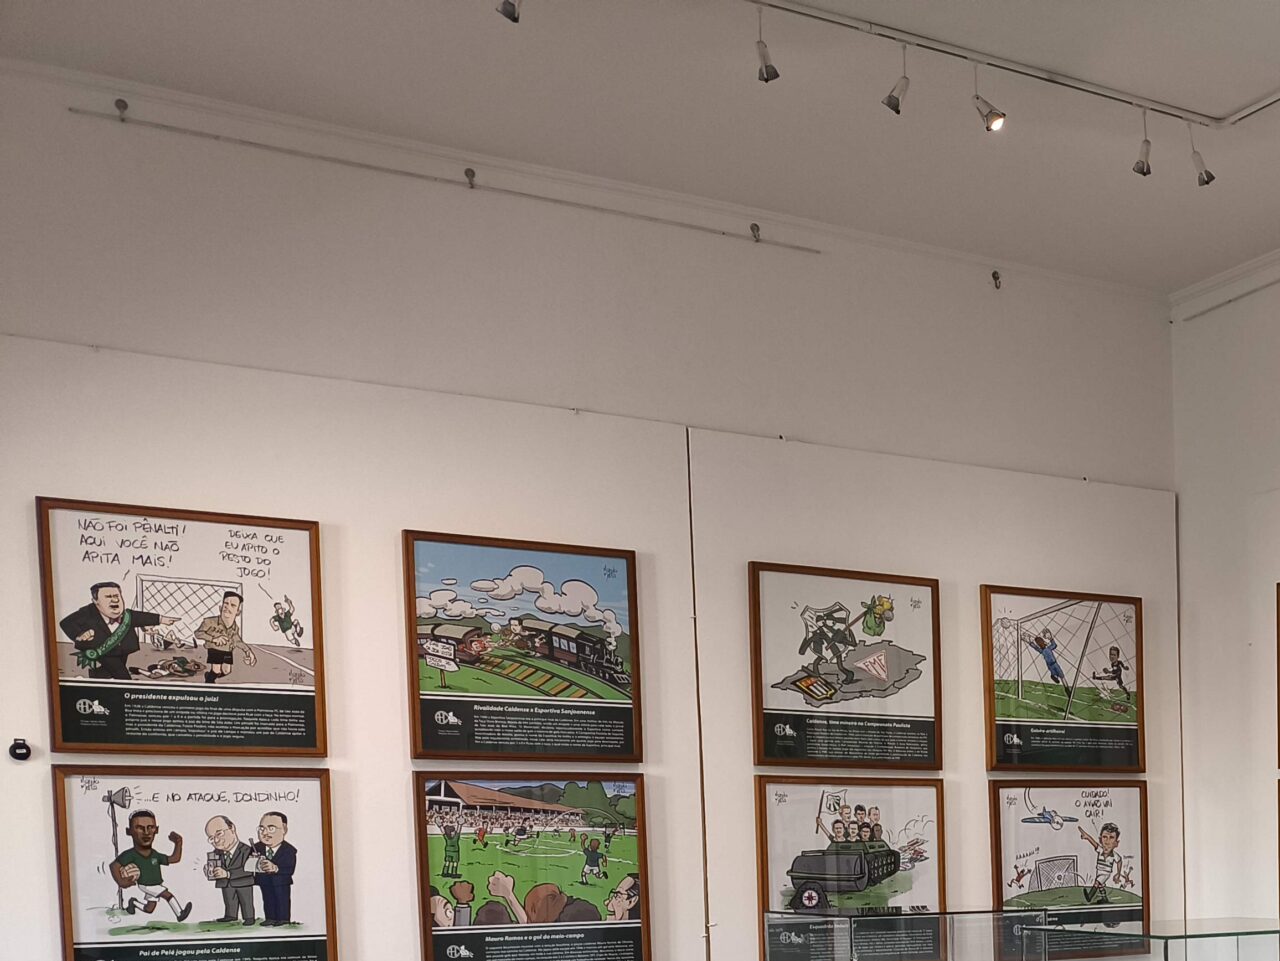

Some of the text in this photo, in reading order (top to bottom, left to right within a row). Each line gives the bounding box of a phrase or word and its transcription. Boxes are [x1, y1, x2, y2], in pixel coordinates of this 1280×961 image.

[78, 518, 104, 531] NÃO
[106, 520, 128, 531] FOI
[228, 529, 285, 543] DEIXA QUE
[80, 534, 179, 552] AQUI VOCÊ NÃO
[225, 541, 238, 550] EU
[241, 543, 267, 554] APITO
[82, 550, 172, 568] APITA MAIS!
[256, 557, 271, 565] DO
[236, 567, 270, 580] JOGO!
[131, 693, 167, 701] presidente
[166, 793, 181, 802] NO
[187, 791, 230, 803] ATAQUE,
[233, 789, 300, 803] DONDINHO!
[175, 948, 194, 956] jogou
